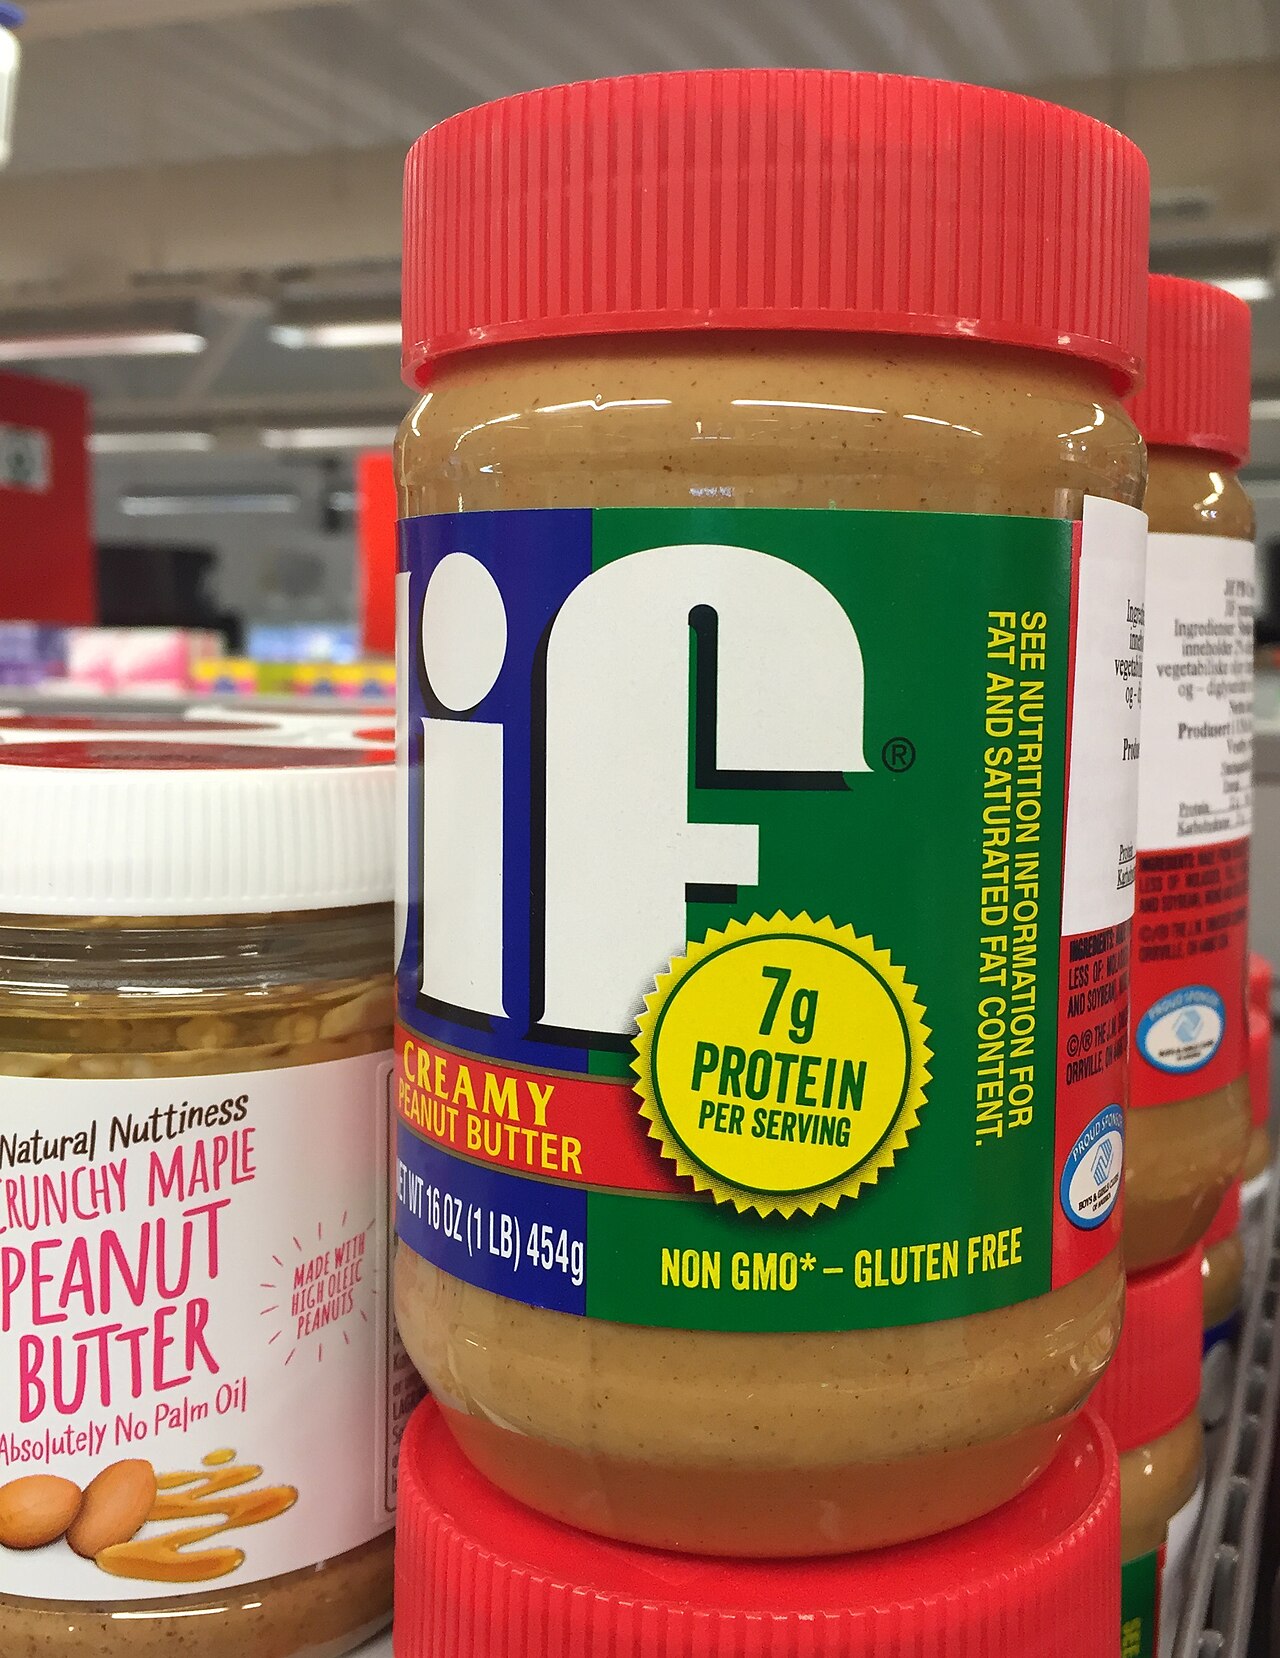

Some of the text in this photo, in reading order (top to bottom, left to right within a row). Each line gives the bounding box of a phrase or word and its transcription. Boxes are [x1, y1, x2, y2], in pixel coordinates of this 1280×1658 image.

[395, 544, 874, 1036] if
[975, 611, 1016, 1147] FAT AND SATURATED FAT CONTENT.
[1008, 611, 1047, 1128] SEE NUTRITION INFORMATION FOR
[759, 965, 819, 1044] 7g
[1067, 993, 1085, 1019] AND
[1068, 962, 1089, 991] LESS
[403, 1040, 555, 1127] CREAMY
[690, 1041, 867, 1112] PROTEIN
[1066, 1050, 1103, 1086] ORRVILLE,
[0, 1094, 249, 1170] Natural Nuttiness
[399, 1077, 583, 1175] PEANUT BUTTER
[698, 1100, 851, 1148] PER SERVING
[1072, 1121, 1101, 1162] PROUD
[148, 1127, 257, 1206] MAPLE
[1, 1198, 232, 1333] PEANUT
[293, 1232, 365, 1290] MADE WITH
[408, 1170, 424, 1219] WT
[426, 1184, 440, 1230] 16
[444, 1193, 463, 1242] OZ
[467, 1203, 481, 1257] (1
[489, 1209, 520, 1272] LB)
[527, 1222, 584, 1286] 454g
[661, 1248, 721, 1289] NON
[855, 1241, 959, 1287] GLUTEN
[968, 1226, 1023, 1275] FREE
[291, 1258, 362, 1316] HIGH OLEIC
[297, 1288, 353, 1339] PEANUTS
[19, 1298, 220, 1424] BUTTER
[0, 1376, 247, 1466] Absolutely No Palm Oil
